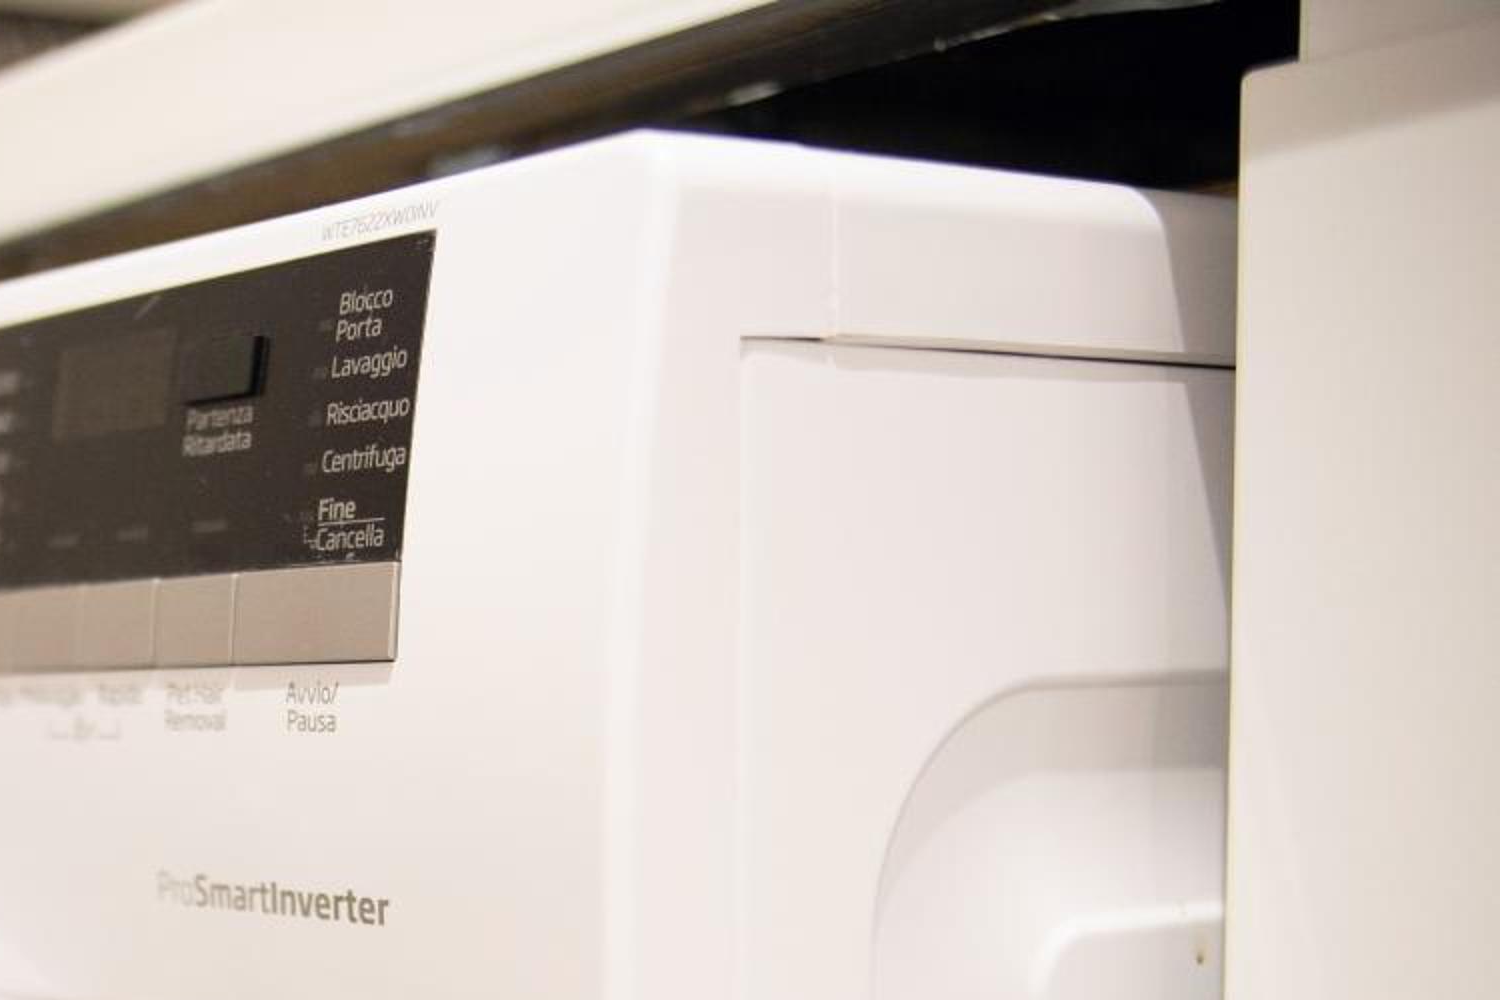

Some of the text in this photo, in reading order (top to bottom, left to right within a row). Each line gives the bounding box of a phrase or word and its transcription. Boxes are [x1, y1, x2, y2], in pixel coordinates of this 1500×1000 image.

[339, 289, 393, 315] Blocco
[335, 317, 382, 342] Porta
[331, 345, 408, 379] Lavaggio
[185, 405, 254, 432] Partenza
[326, 397, 411, 425] Risciacquo
[181, 431, 252, 457] Ritardata
[321, 443, 406, 472] Centrifuga
[318, 497, 357, 521] Fine
[316, 523, 385, 551] Cancella
[285, 681, 340, 705] Avvio/
[286, 708, 337, 732] Pausa
[156, 869, 390, 927] ProSmartInverter
